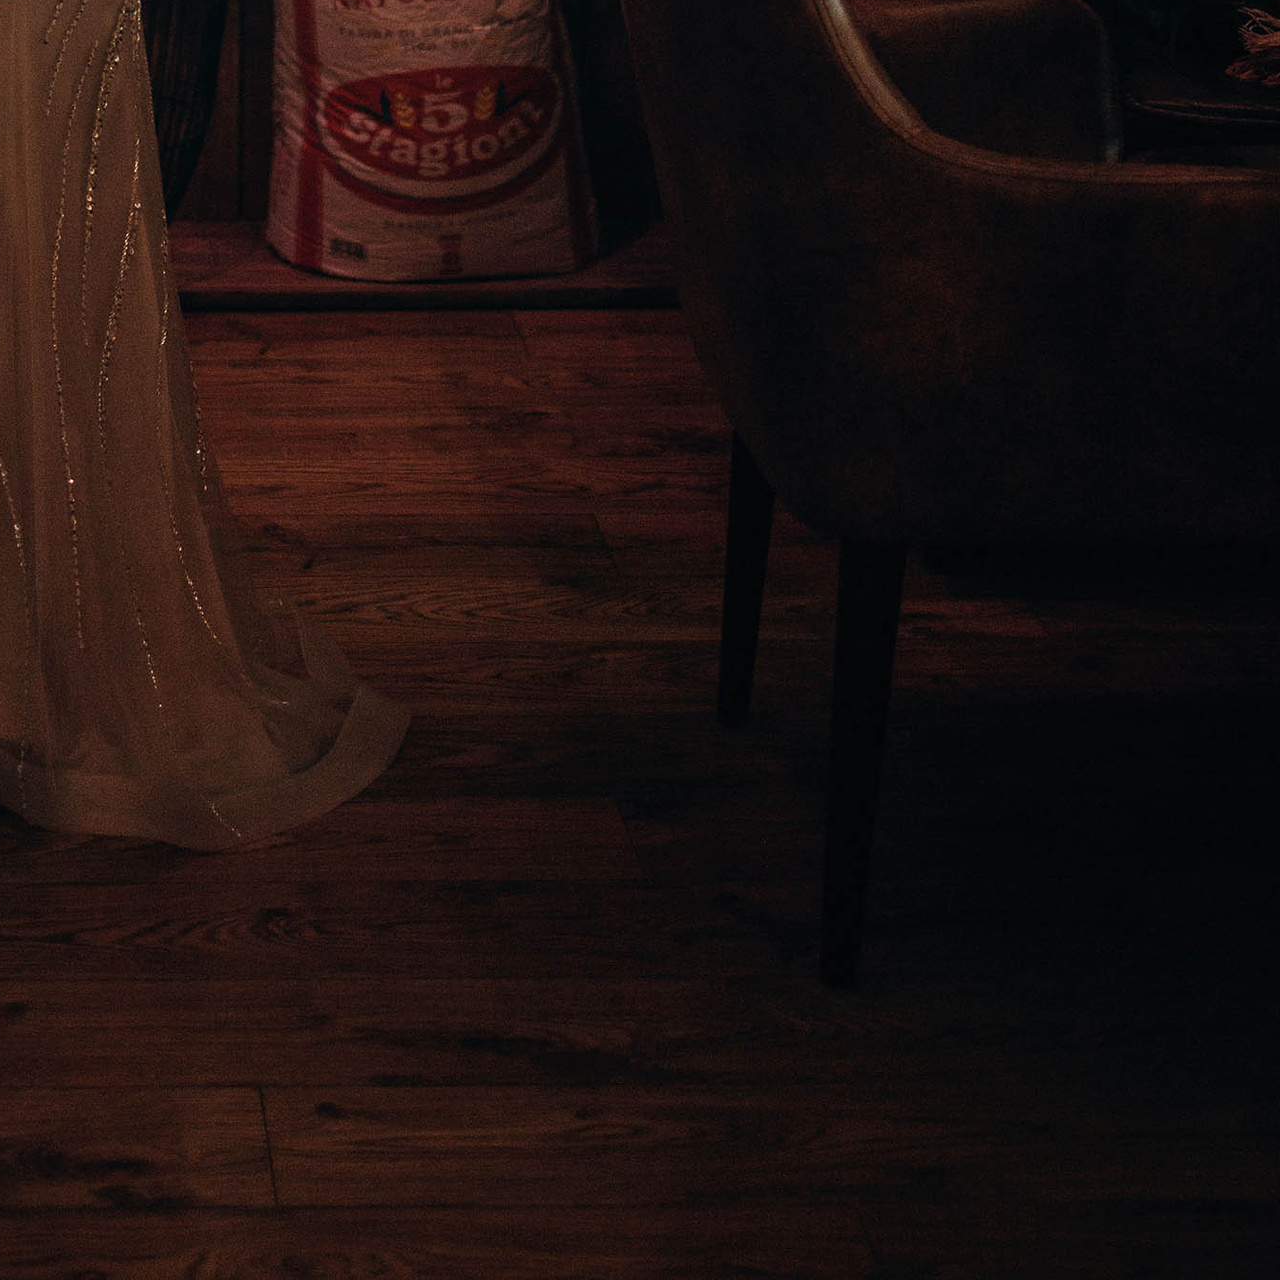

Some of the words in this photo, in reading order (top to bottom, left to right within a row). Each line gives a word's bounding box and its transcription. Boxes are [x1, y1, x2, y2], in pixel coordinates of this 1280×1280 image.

[435, 73, 455, 89] le
[420, 90, 470, 134] 5
[341, 100, 544, 178] Stagioni
